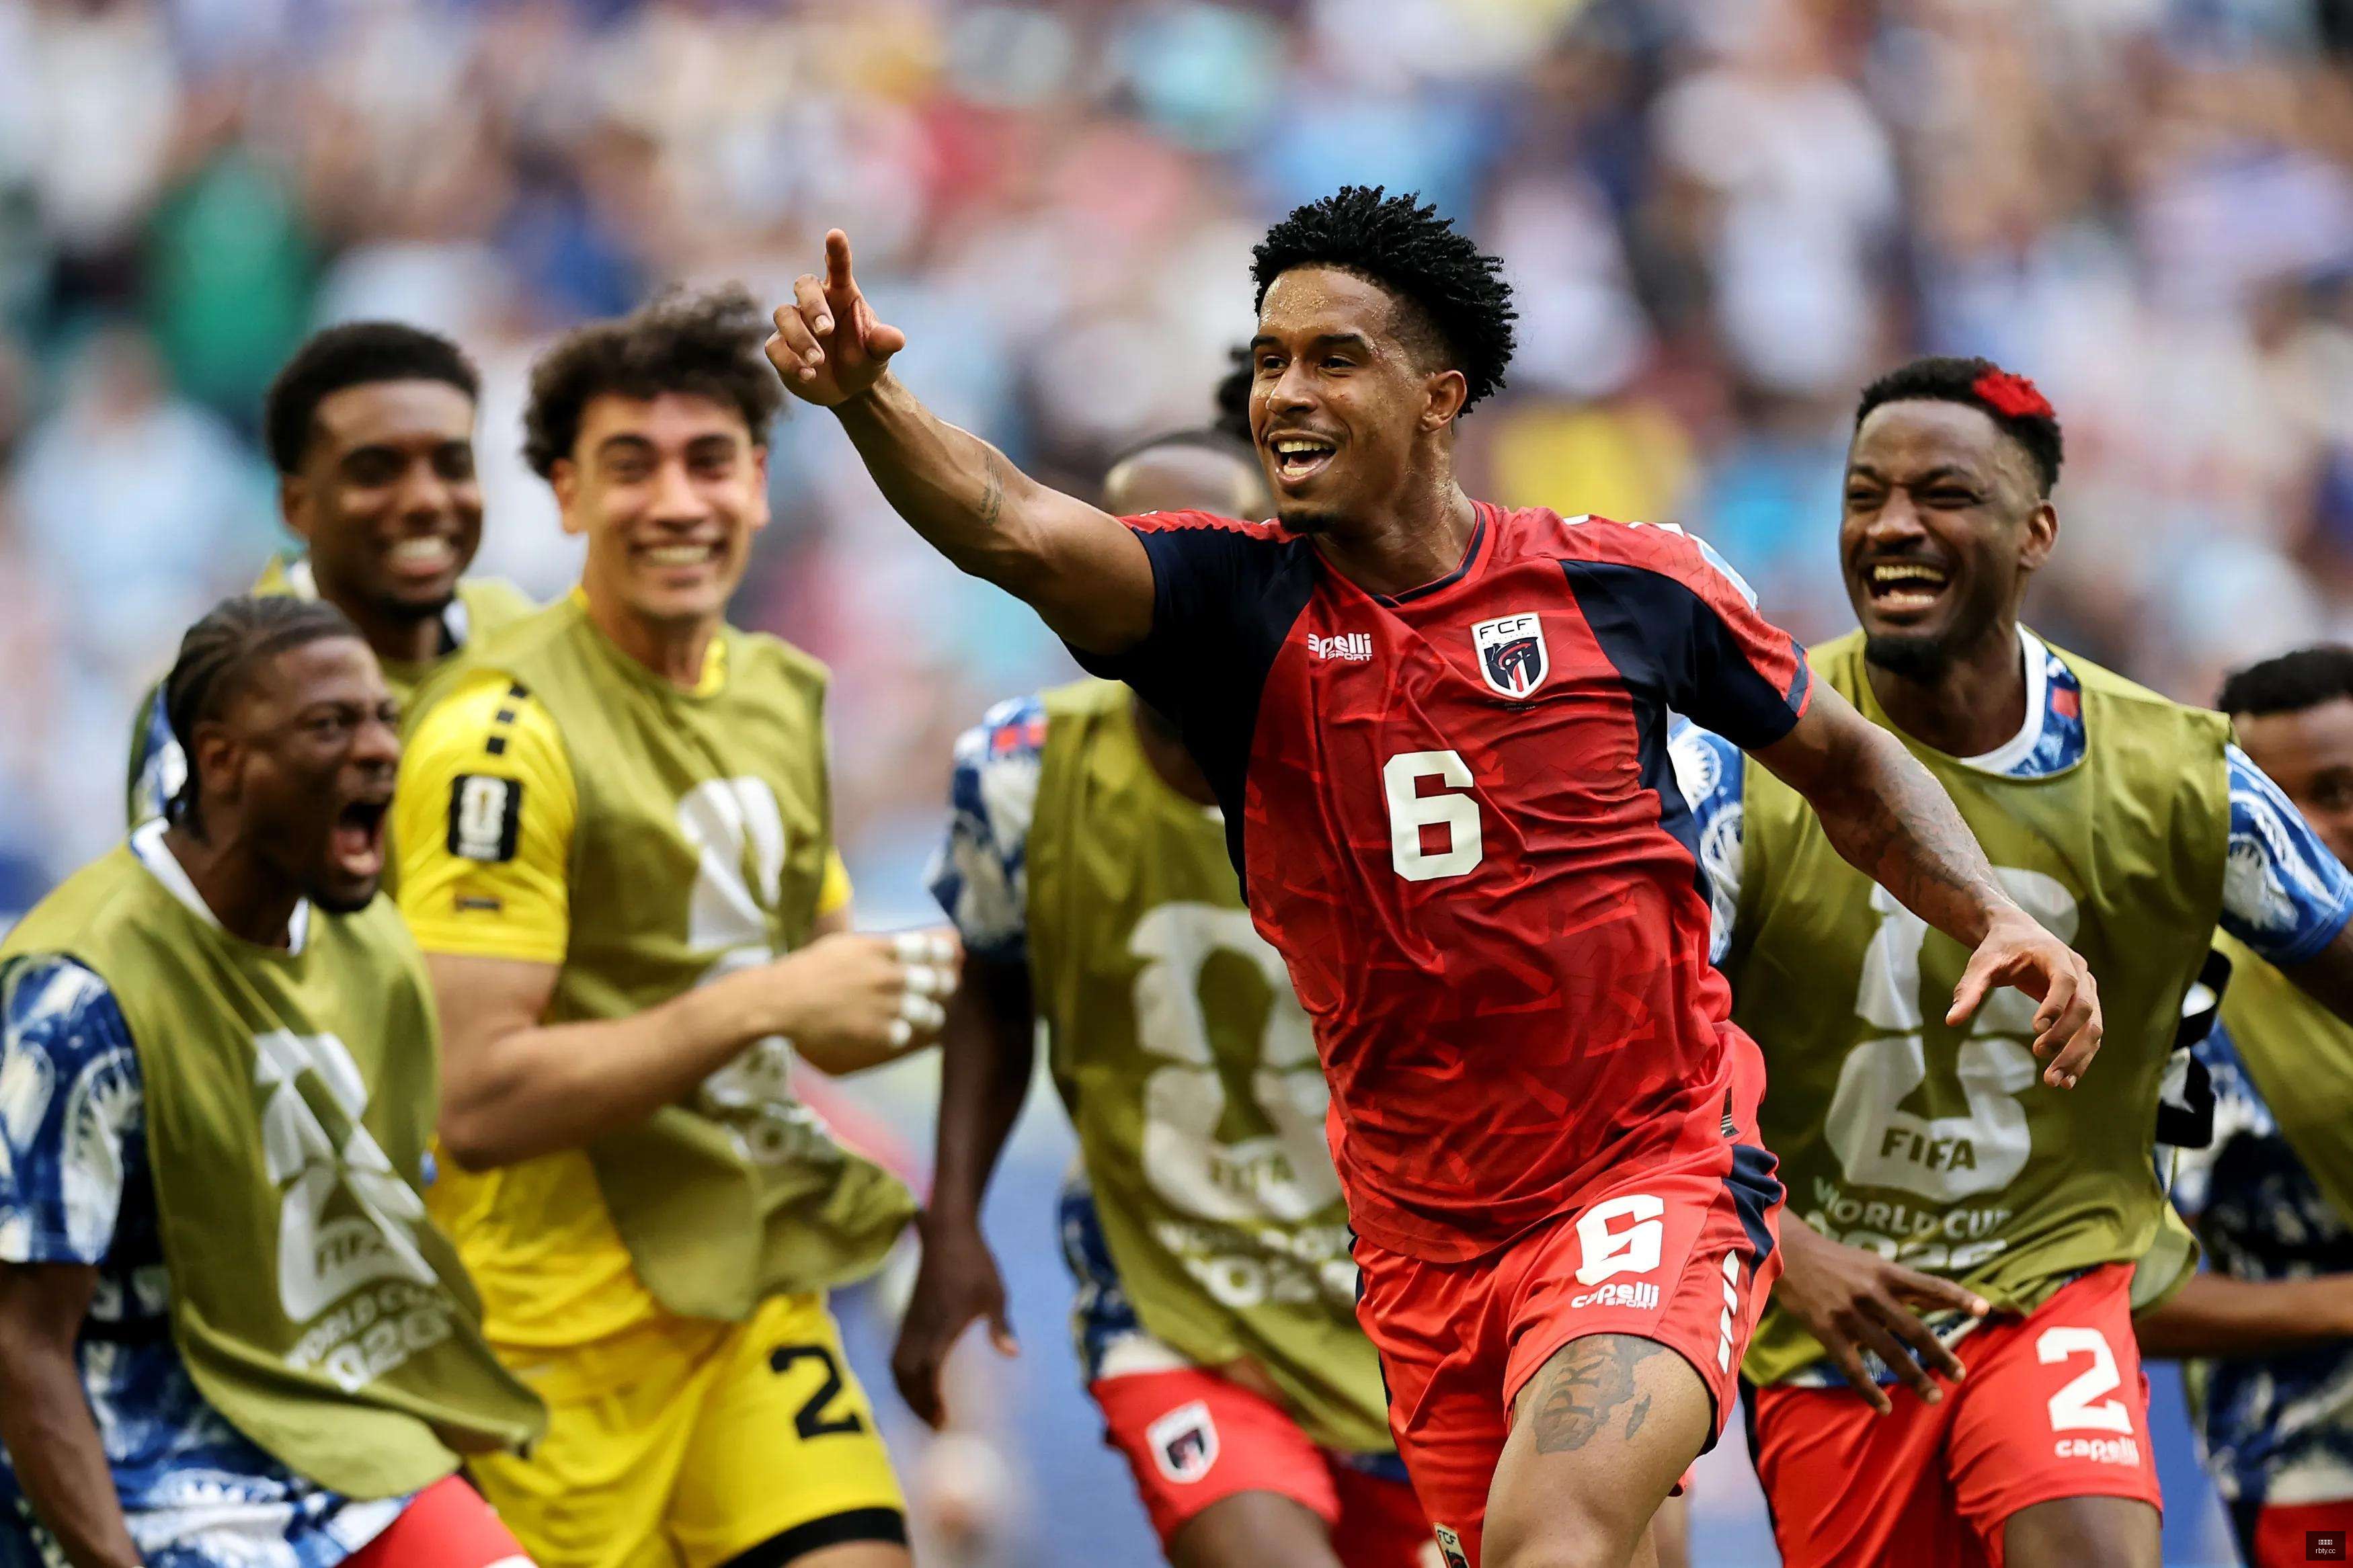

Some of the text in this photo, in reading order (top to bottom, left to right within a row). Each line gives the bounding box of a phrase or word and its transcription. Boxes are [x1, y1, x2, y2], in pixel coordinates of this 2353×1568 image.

[1308, 632, 1372, 659] apelli
[1479, 618, 1533, 639] FCF
[1327, 650, 1373, 661] SPORT
[1382, 749, 1483, 882] 6
[1880, 1127, 1977, 1171] FIFA
[1574, 1194, 1665, 1286] 6
[770, 1345, 863, 1440] 2
[2035, 1326, 2134, 1435] 2
[1437, 1529, 1456, 1545] FCF
